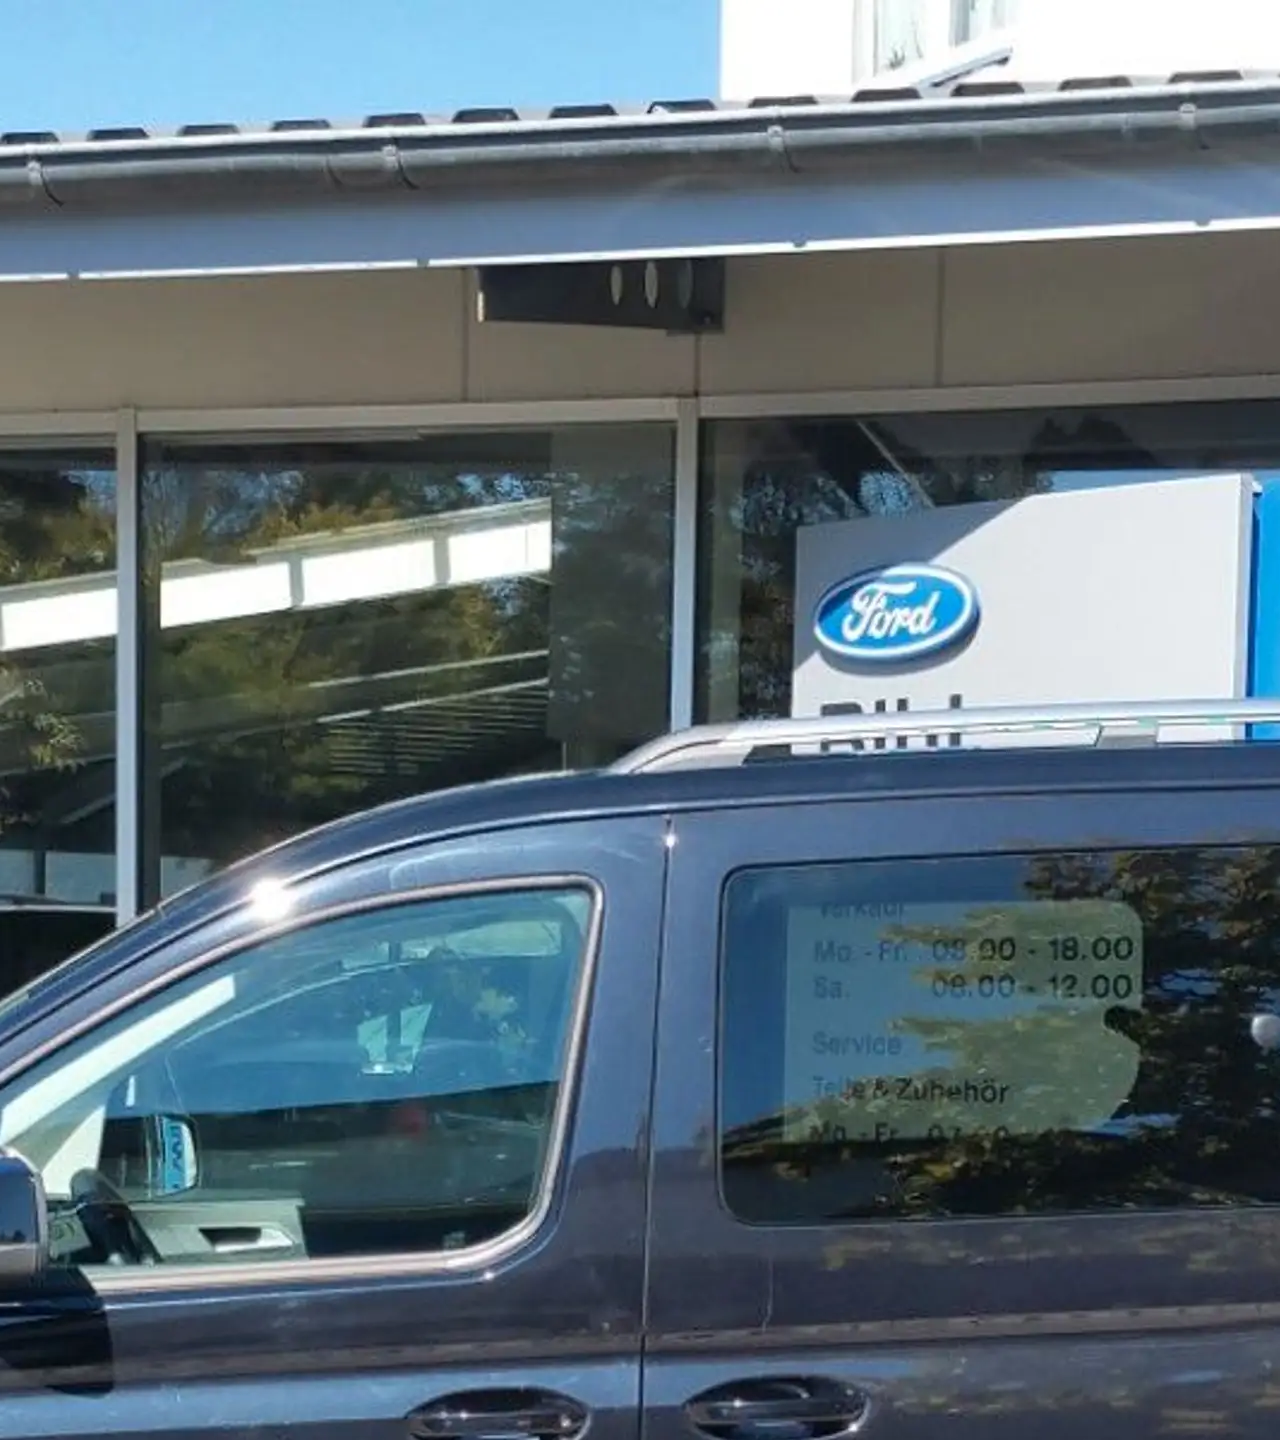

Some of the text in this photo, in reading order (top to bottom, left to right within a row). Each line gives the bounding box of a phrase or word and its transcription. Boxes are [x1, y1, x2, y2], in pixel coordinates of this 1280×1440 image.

[842, 580, 943, 641] Ford
[1048, 936, 1134, 962] 18.00
[931, 974, 1016, 999] 08.00
[1048, 973, 1133, 999] 12.00
[812, 1030, 904, 1057] Service
[895, 1077, 1010, 1104] Zubehör
